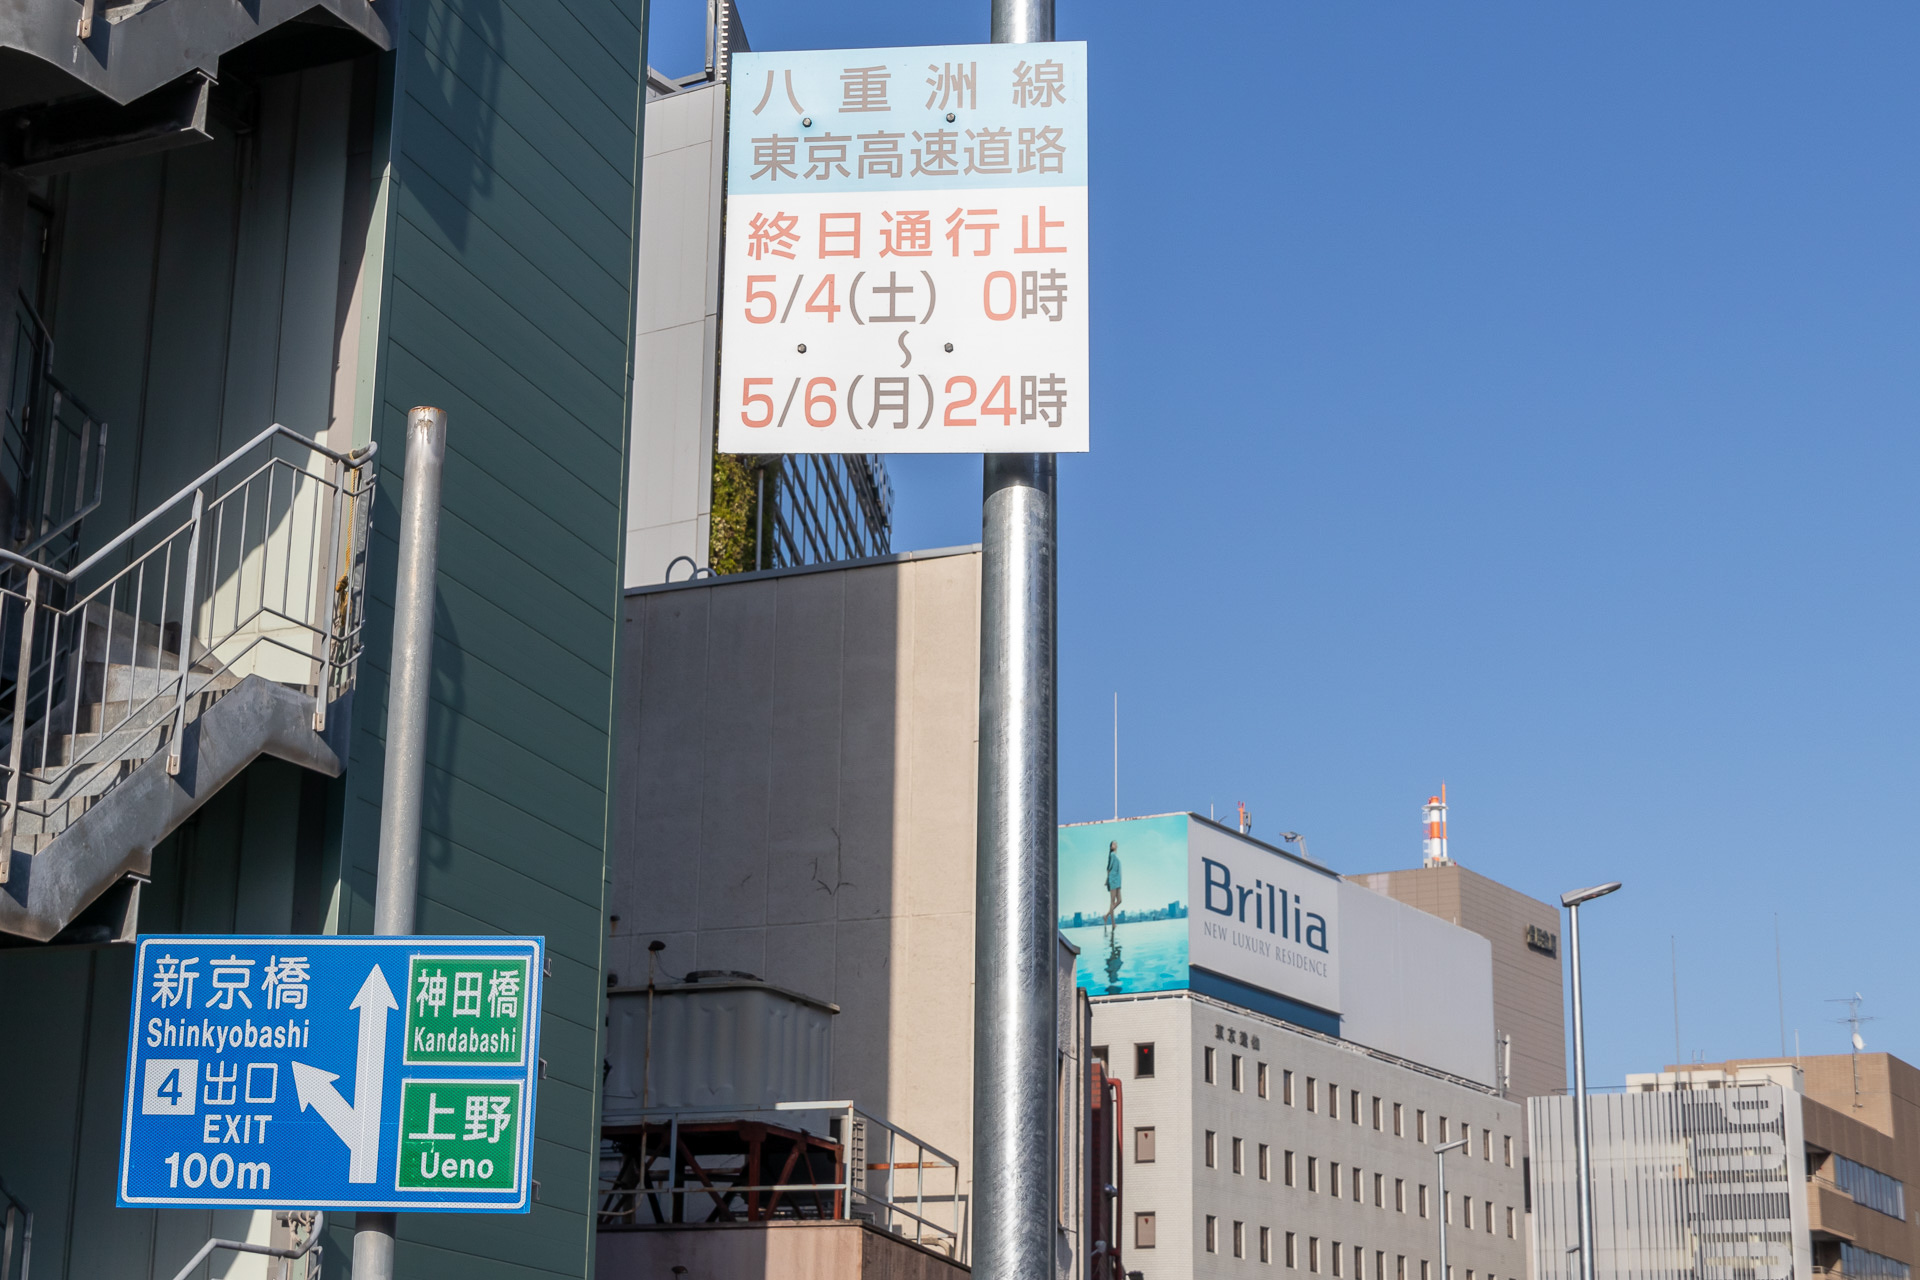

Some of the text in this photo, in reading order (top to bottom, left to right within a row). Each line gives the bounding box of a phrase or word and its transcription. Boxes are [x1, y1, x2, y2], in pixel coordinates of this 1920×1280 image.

[752, 58, 1067, 115] 八重洲線
[750, 125, 1067, 181] 東京高速道路
[747, 206, 1067, 260] 終日通行止
[744, 268, 1067, 325] 5/4(土) 0時
[1202, 857, 1328, 954] Brillia
[1204, 921, 1328, 978] NEW LUXURY RESIDENCE
[151, 954, 310, 1010] 新京橋
[416, 969, 520, 1018] 神田橋
[147, 1017, 309, 1053] Shinkyobashi
[413, 1026, 516, 1054] Kandabashi
[157, 1060, 278, 1106] 4 出口
[203, 1114, 272, 1144] EXIT
[408, 1092, 511, 1144] 上野
[165, 1152, 271, 1190] 100m
[420, 1152, 494, 1180] Ueno
